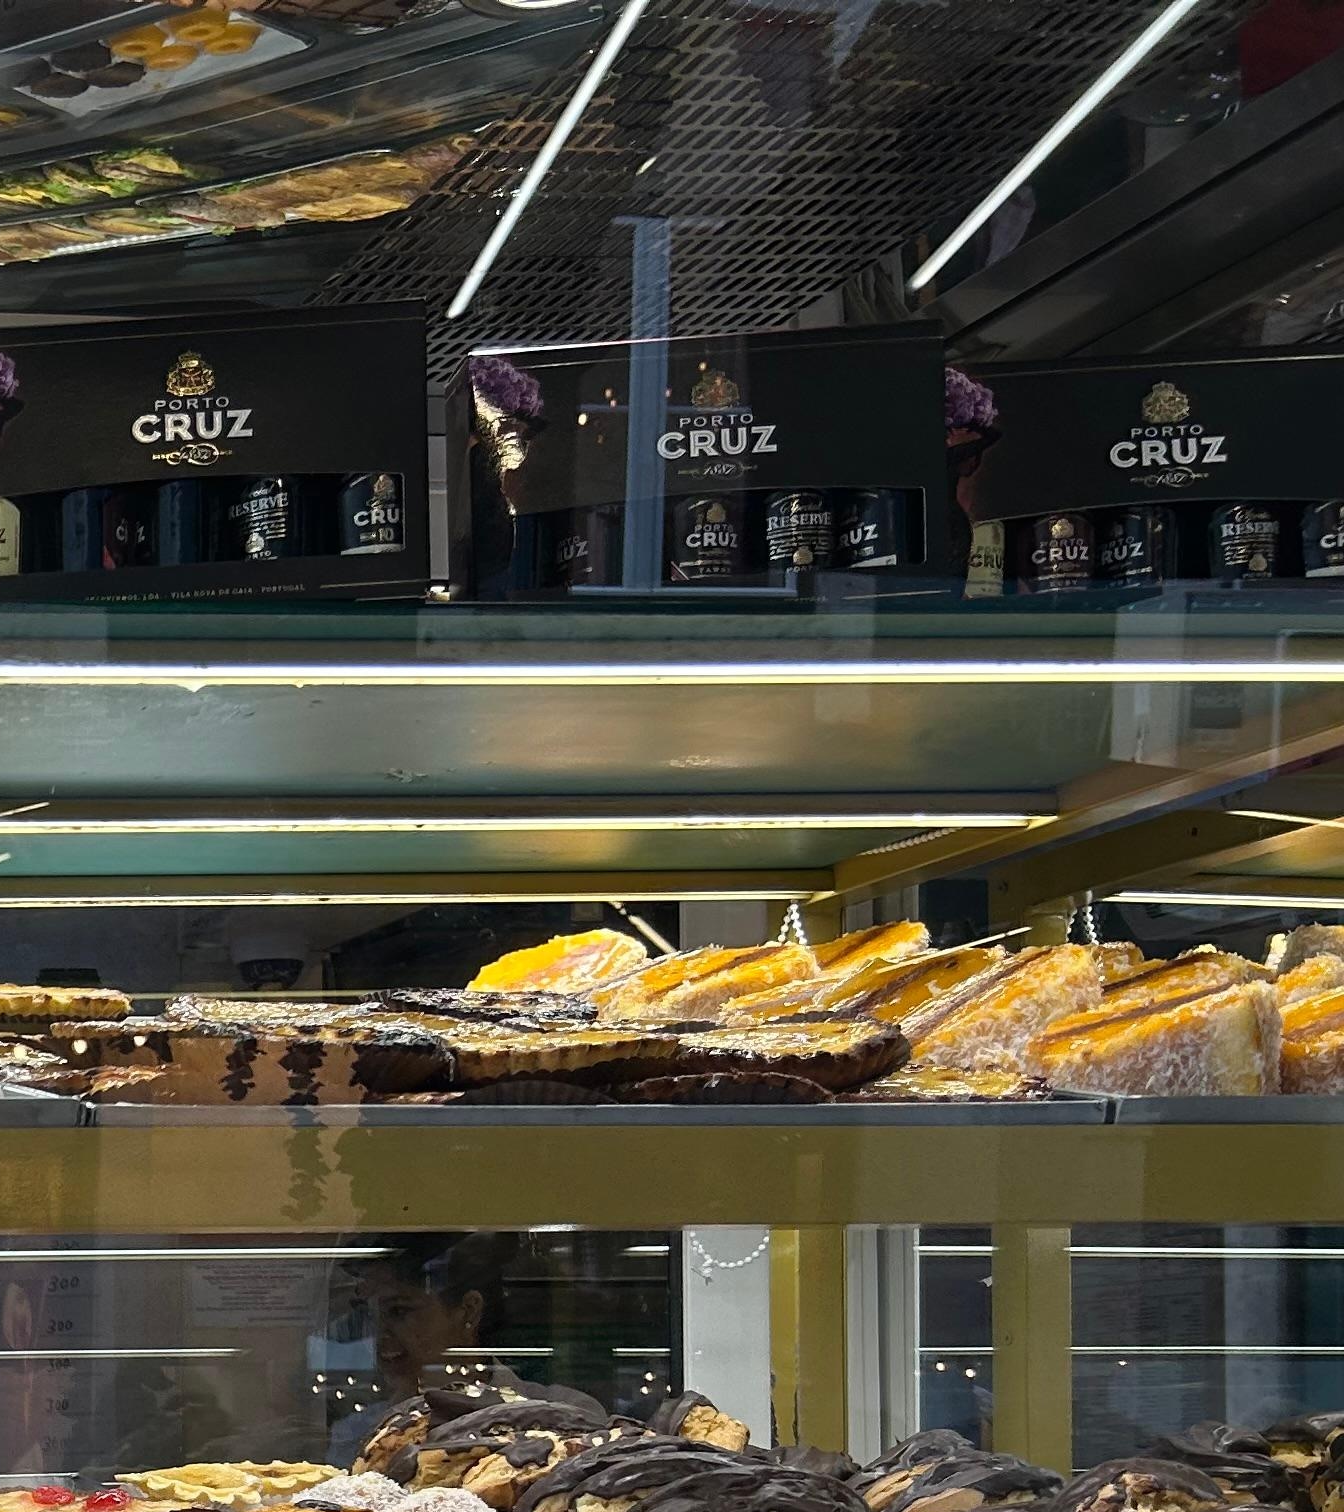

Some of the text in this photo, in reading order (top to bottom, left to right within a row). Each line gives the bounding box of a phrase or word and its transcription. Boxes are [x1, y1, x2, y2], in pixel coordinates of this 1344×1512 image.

[154, 396, 230, 412] PORTO
[131, 409, 253, 444] CRUZ
[679, 413, 754, 429] PORTO
[1131, 424, 1204, 439] PORTO
[657, 425, 777, 460] CRUZ
[1109, 436, 1228, 468] CRUZ
[354, 508, 401, 528] CRU
[766, 512, 832, 532] RESERVE
[686, 532, 739, 548] CRUZ
[968, 553, 1003, 569] CRU
[1031, 546, 1090, 564] CRUZ
